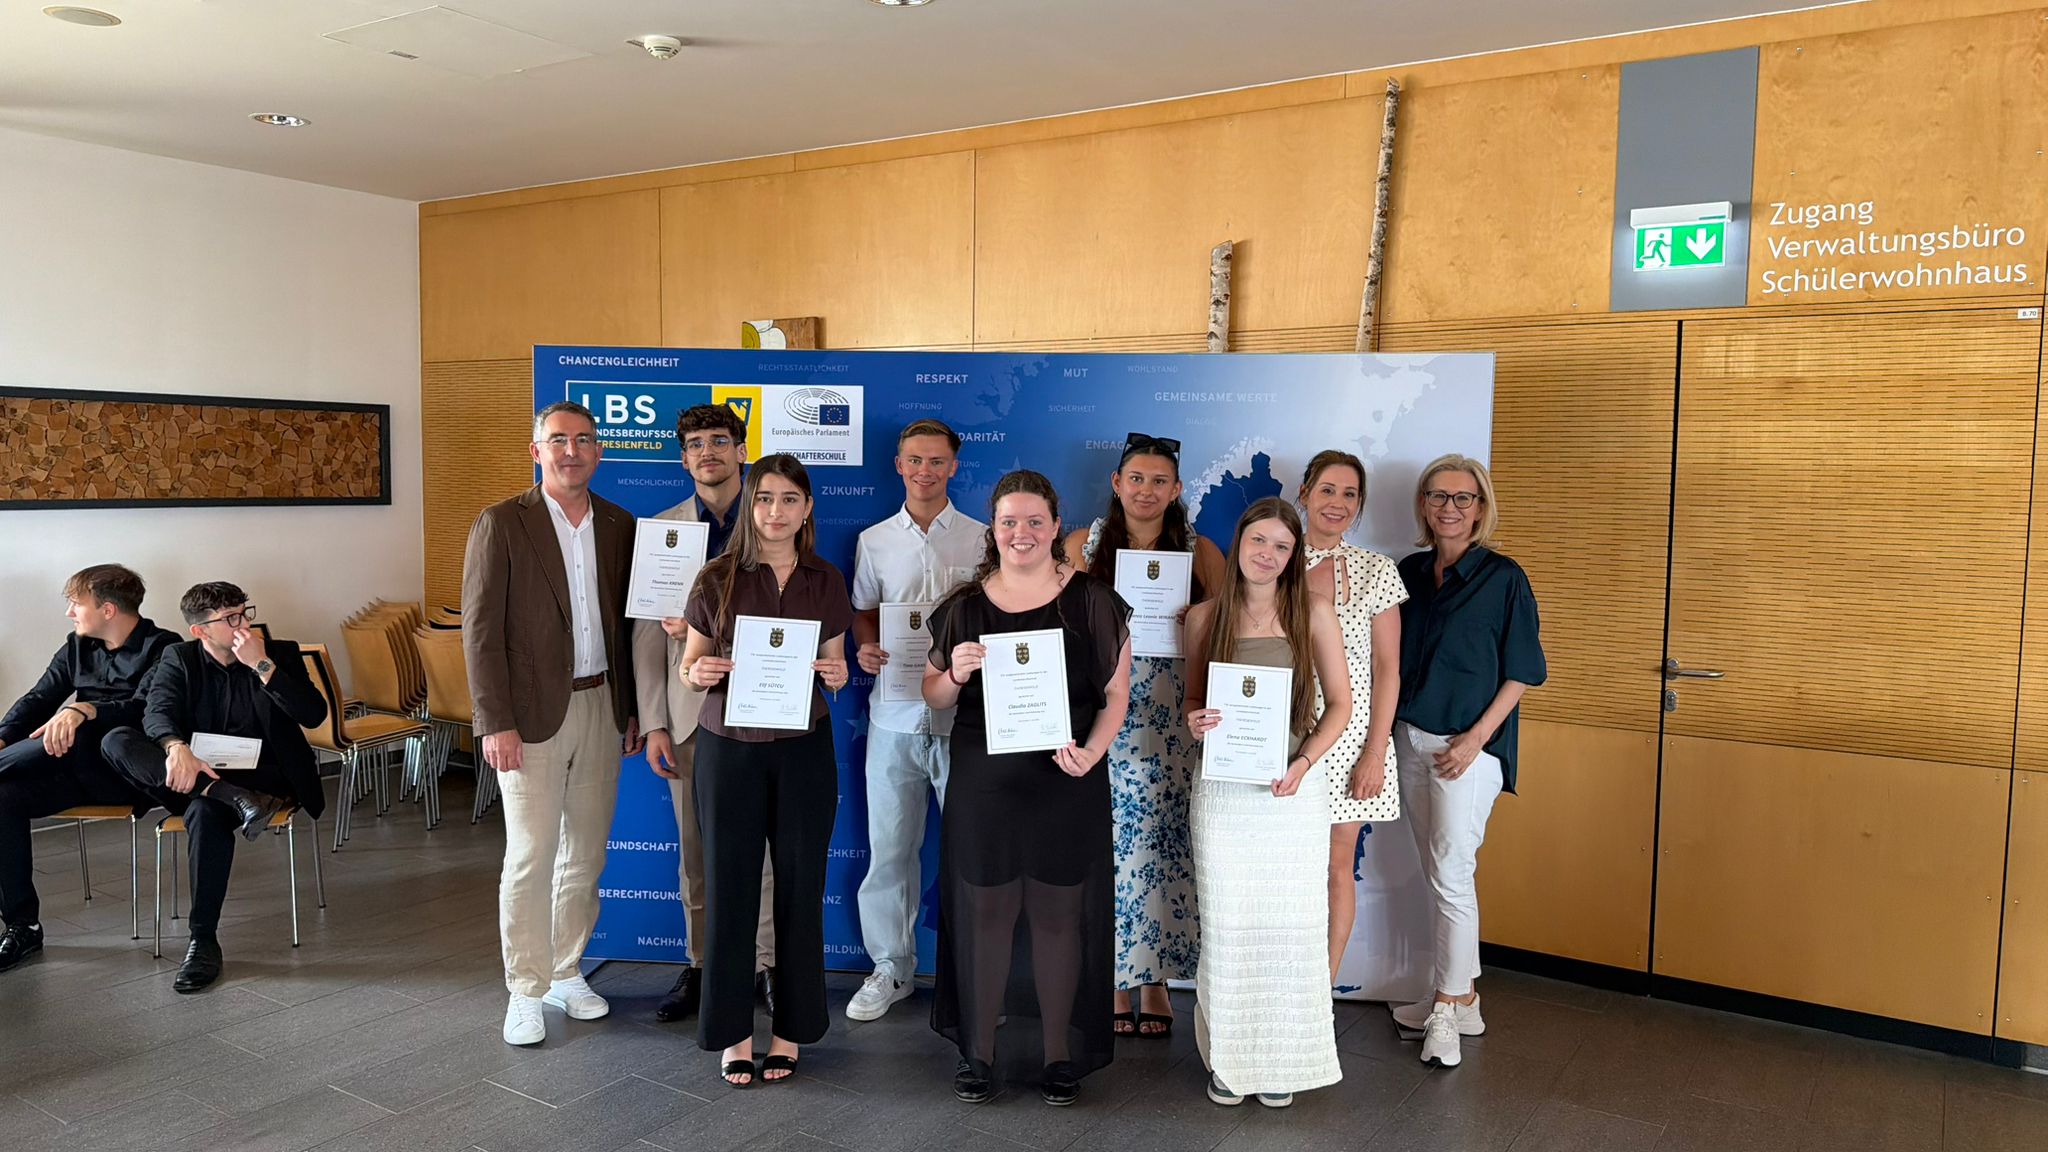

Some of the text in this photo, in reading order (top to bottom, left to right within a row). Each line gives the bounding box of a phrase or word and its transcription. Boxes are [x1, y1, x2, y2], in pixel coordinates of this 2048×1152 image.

[1769, 200, 1874, 228] Zugang
[1767, 223, 2026, 259] Verwaltungsbüro
[1761, 260, 2028, 294] Schülerwohnhaus
[558, 355, 680, 368] CHANCENGLEICHHEIT
[758, 363, 849, 374] RECHTSSTAATLICHKEIT
[1063, 368, 1088, 378] MUT
[1127, 365, 1178, 373] WOHLSTAND
[916, 373, 968, 384] RESPEKT
[1154, 391, 1277, 402] GEMEINSAME WERTE
[582, 394, 656, 425] LBS
[899, 402, 943, 411] HOFFNUNG
[1048, 403, 1096, 413] SICHERHEIT
[771, 427, 850, 437] Europäisches Parlament
[956, 430, 1006, 442] DARITÄT
[598, 440, 663, 450] RESIENFELD
[1085, 439, 1124, 450] ENGAG
[617, 478, 685, 487] MENSCHLICHKEIT
[821, 486, 875, 496] ZUKUNFT
[852, 676, 874, 686] EUR
[606, 840, 679, 852] EUNDSCHAFT
[827, 848, 866, 859] CHKEIT
[637, 936, 688, 947] NACHHAL
[824, 944, 865, 954] BILDUN
